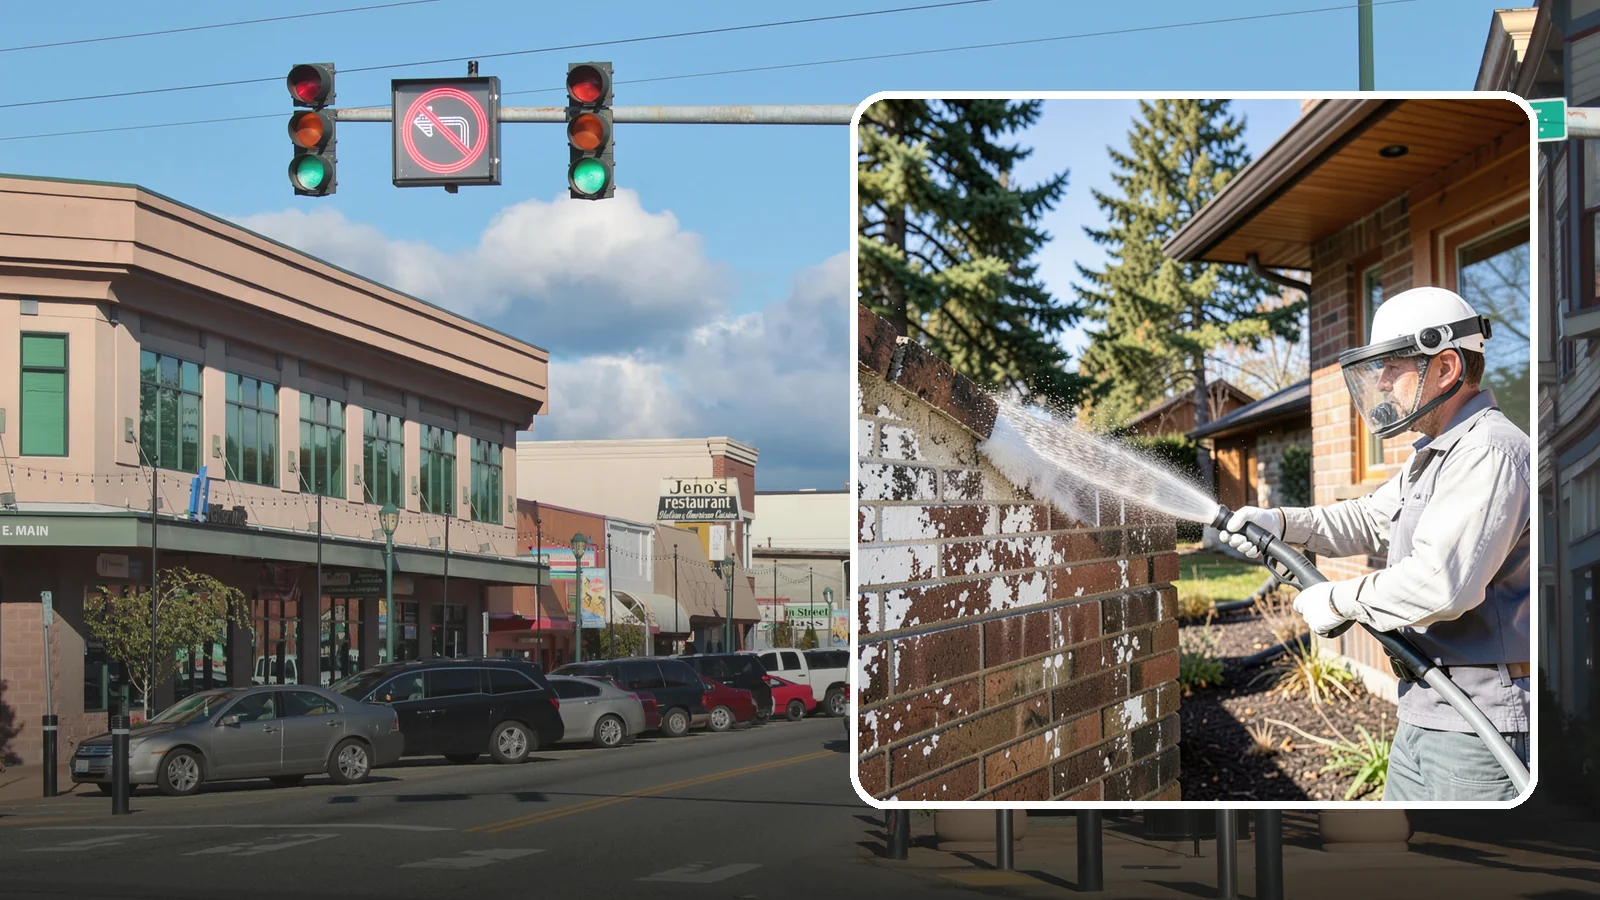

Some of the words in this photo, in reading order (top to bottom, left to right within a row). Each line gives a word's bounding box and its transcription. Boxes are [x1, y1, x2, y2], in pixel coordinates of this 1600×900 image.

[670, 480, 727, 494] Jeno's
[665, 496, 731, 509] restaurant
[659, 510, 681, 519] Italian
[686, 510, 714, 519] American
[715, 509, 737, 519] Cuisine
[2, 525, 13, 536] E.
[15, 525, 49, 536] MAIN
[797, 607, 828, 616] Street
